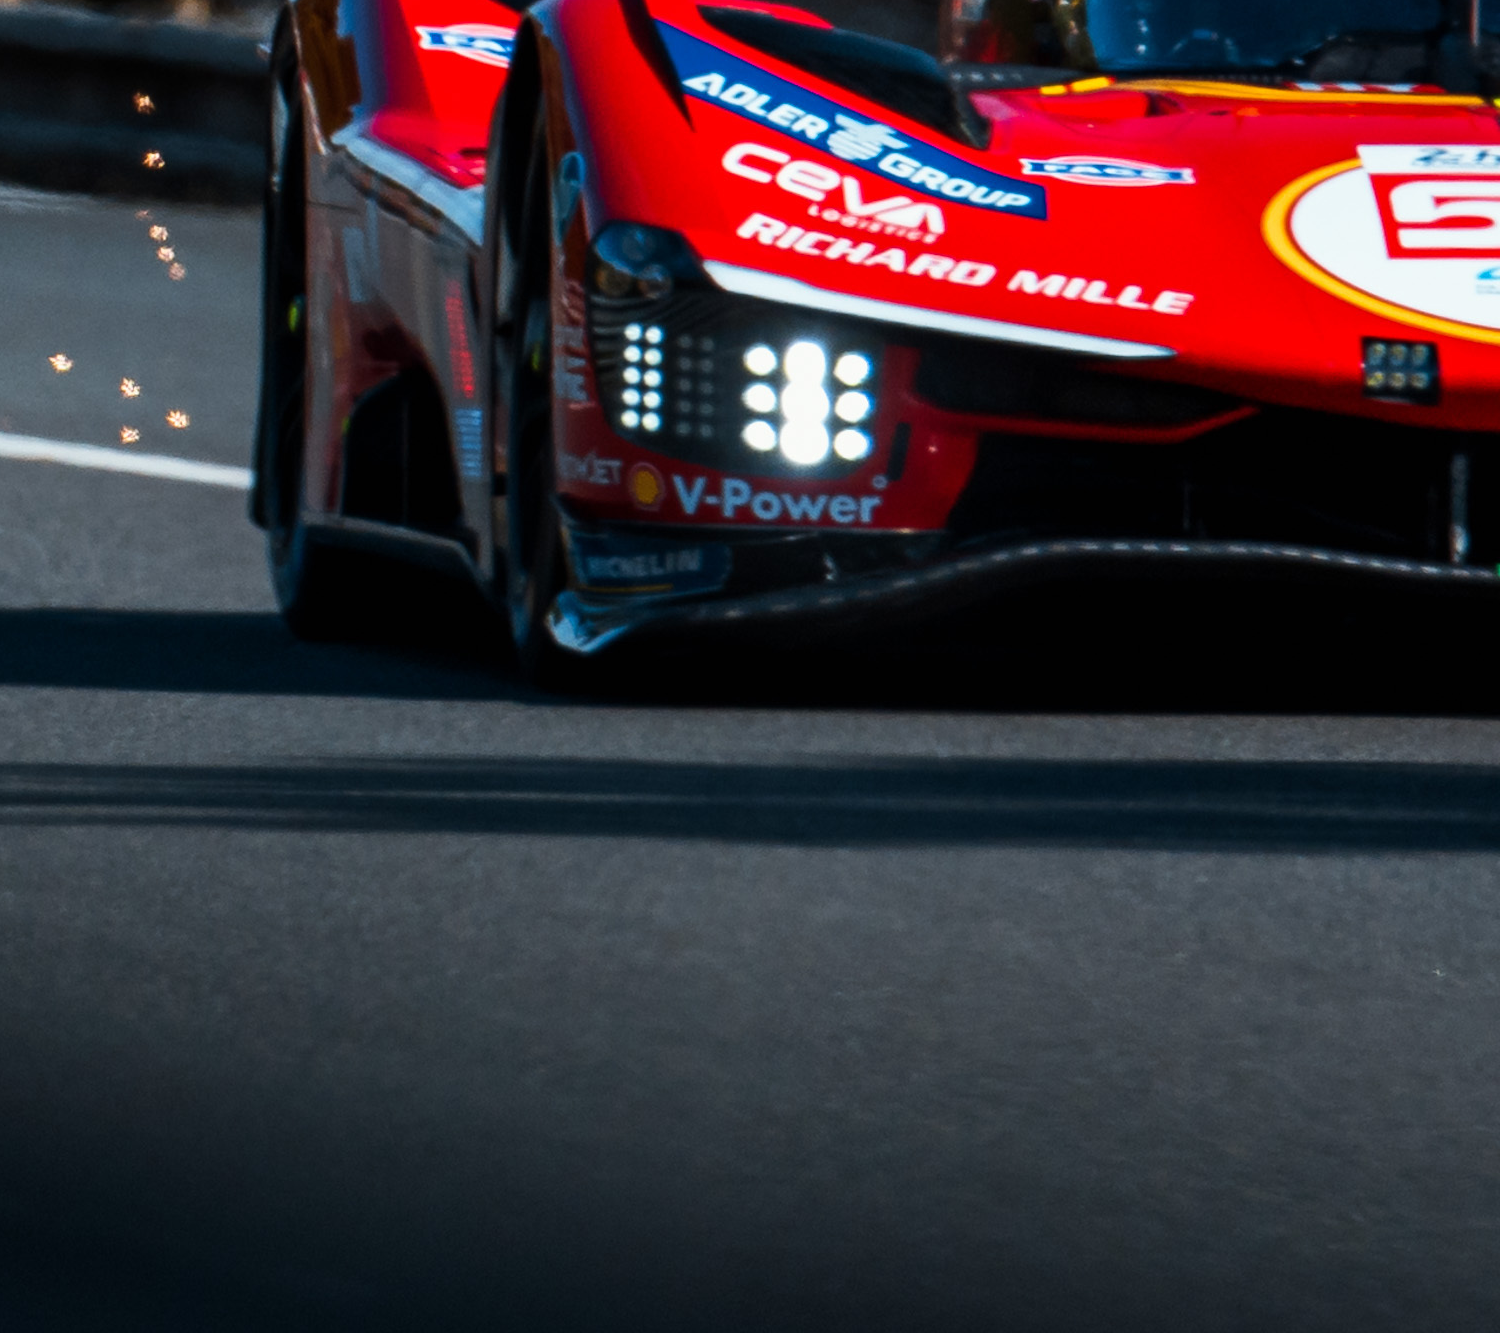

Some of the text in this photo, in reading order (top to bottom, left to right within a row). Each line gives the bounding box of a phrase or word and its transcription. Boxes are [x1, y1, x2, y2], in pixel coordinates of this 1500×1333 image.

[683, 71, 1032, 209] ADLER GROUP
[807, 203, 941, 245] LOGISTICS
[737, 211, 1195, 316] RICHARD MILLE
[671, 473, 883, 523] V-Power
